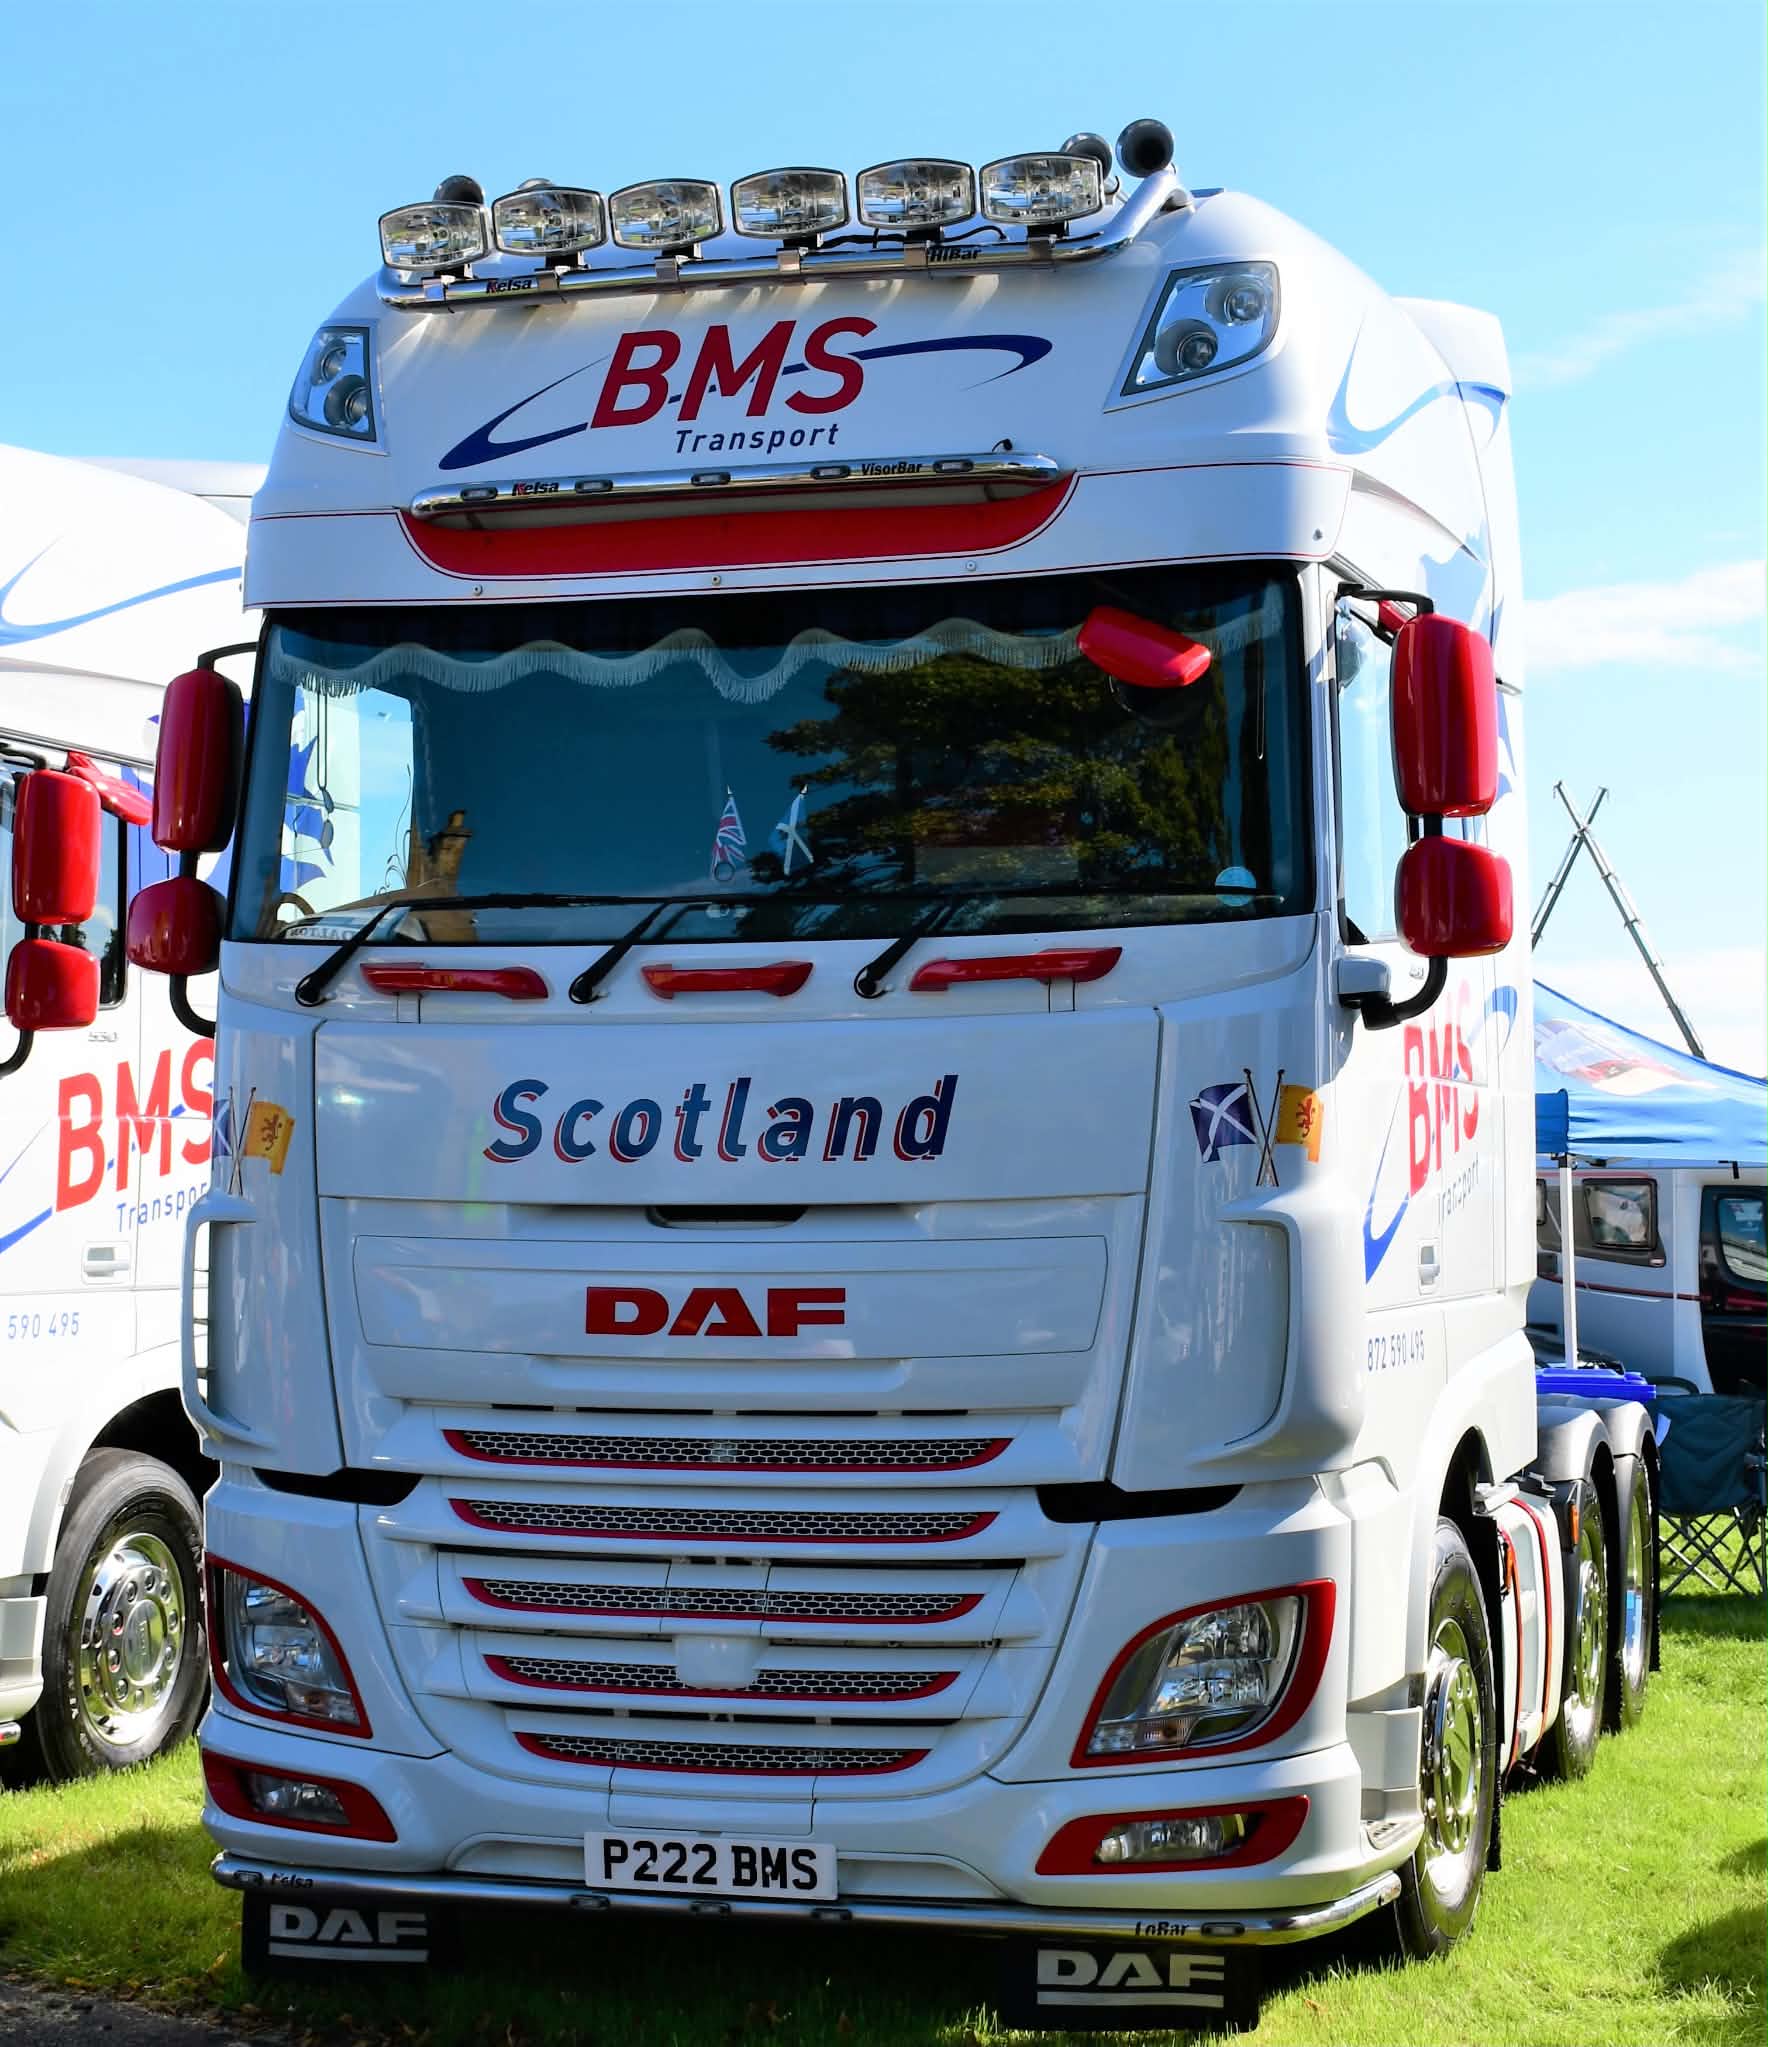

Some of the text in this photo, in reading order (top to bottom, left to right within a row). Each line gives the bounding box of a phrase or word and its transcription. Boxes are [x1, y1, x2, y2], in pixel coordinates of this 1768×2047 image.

[486, 278, 532, 293] Kelsa
[590, 317, 877, 430] BMS
[675, 421, 839, 455] Transport
[511, 480, 560, 496] Kelsa
[861, 460, 922, 476] VisorBar
[1404, 980, 1479, 1198] BMS
[56, 1038, 215, 1213] BMS
[483, 1075, 959, 1164] Scotland
[117, 1182, 208, 1233] Transpor
[8, 1311, 80, 1340] 590 495
[586, 1286, 846, 1337] DAF
[1367, 1338, 1387, 1372] 872
[1391, 1333, 1407, 1368] 590
[603, 1838, 818, 1891] P222 BMS
[270, 1904, 428, 1944] DAF
[1037, 1949, 1225, 1987] DAF
